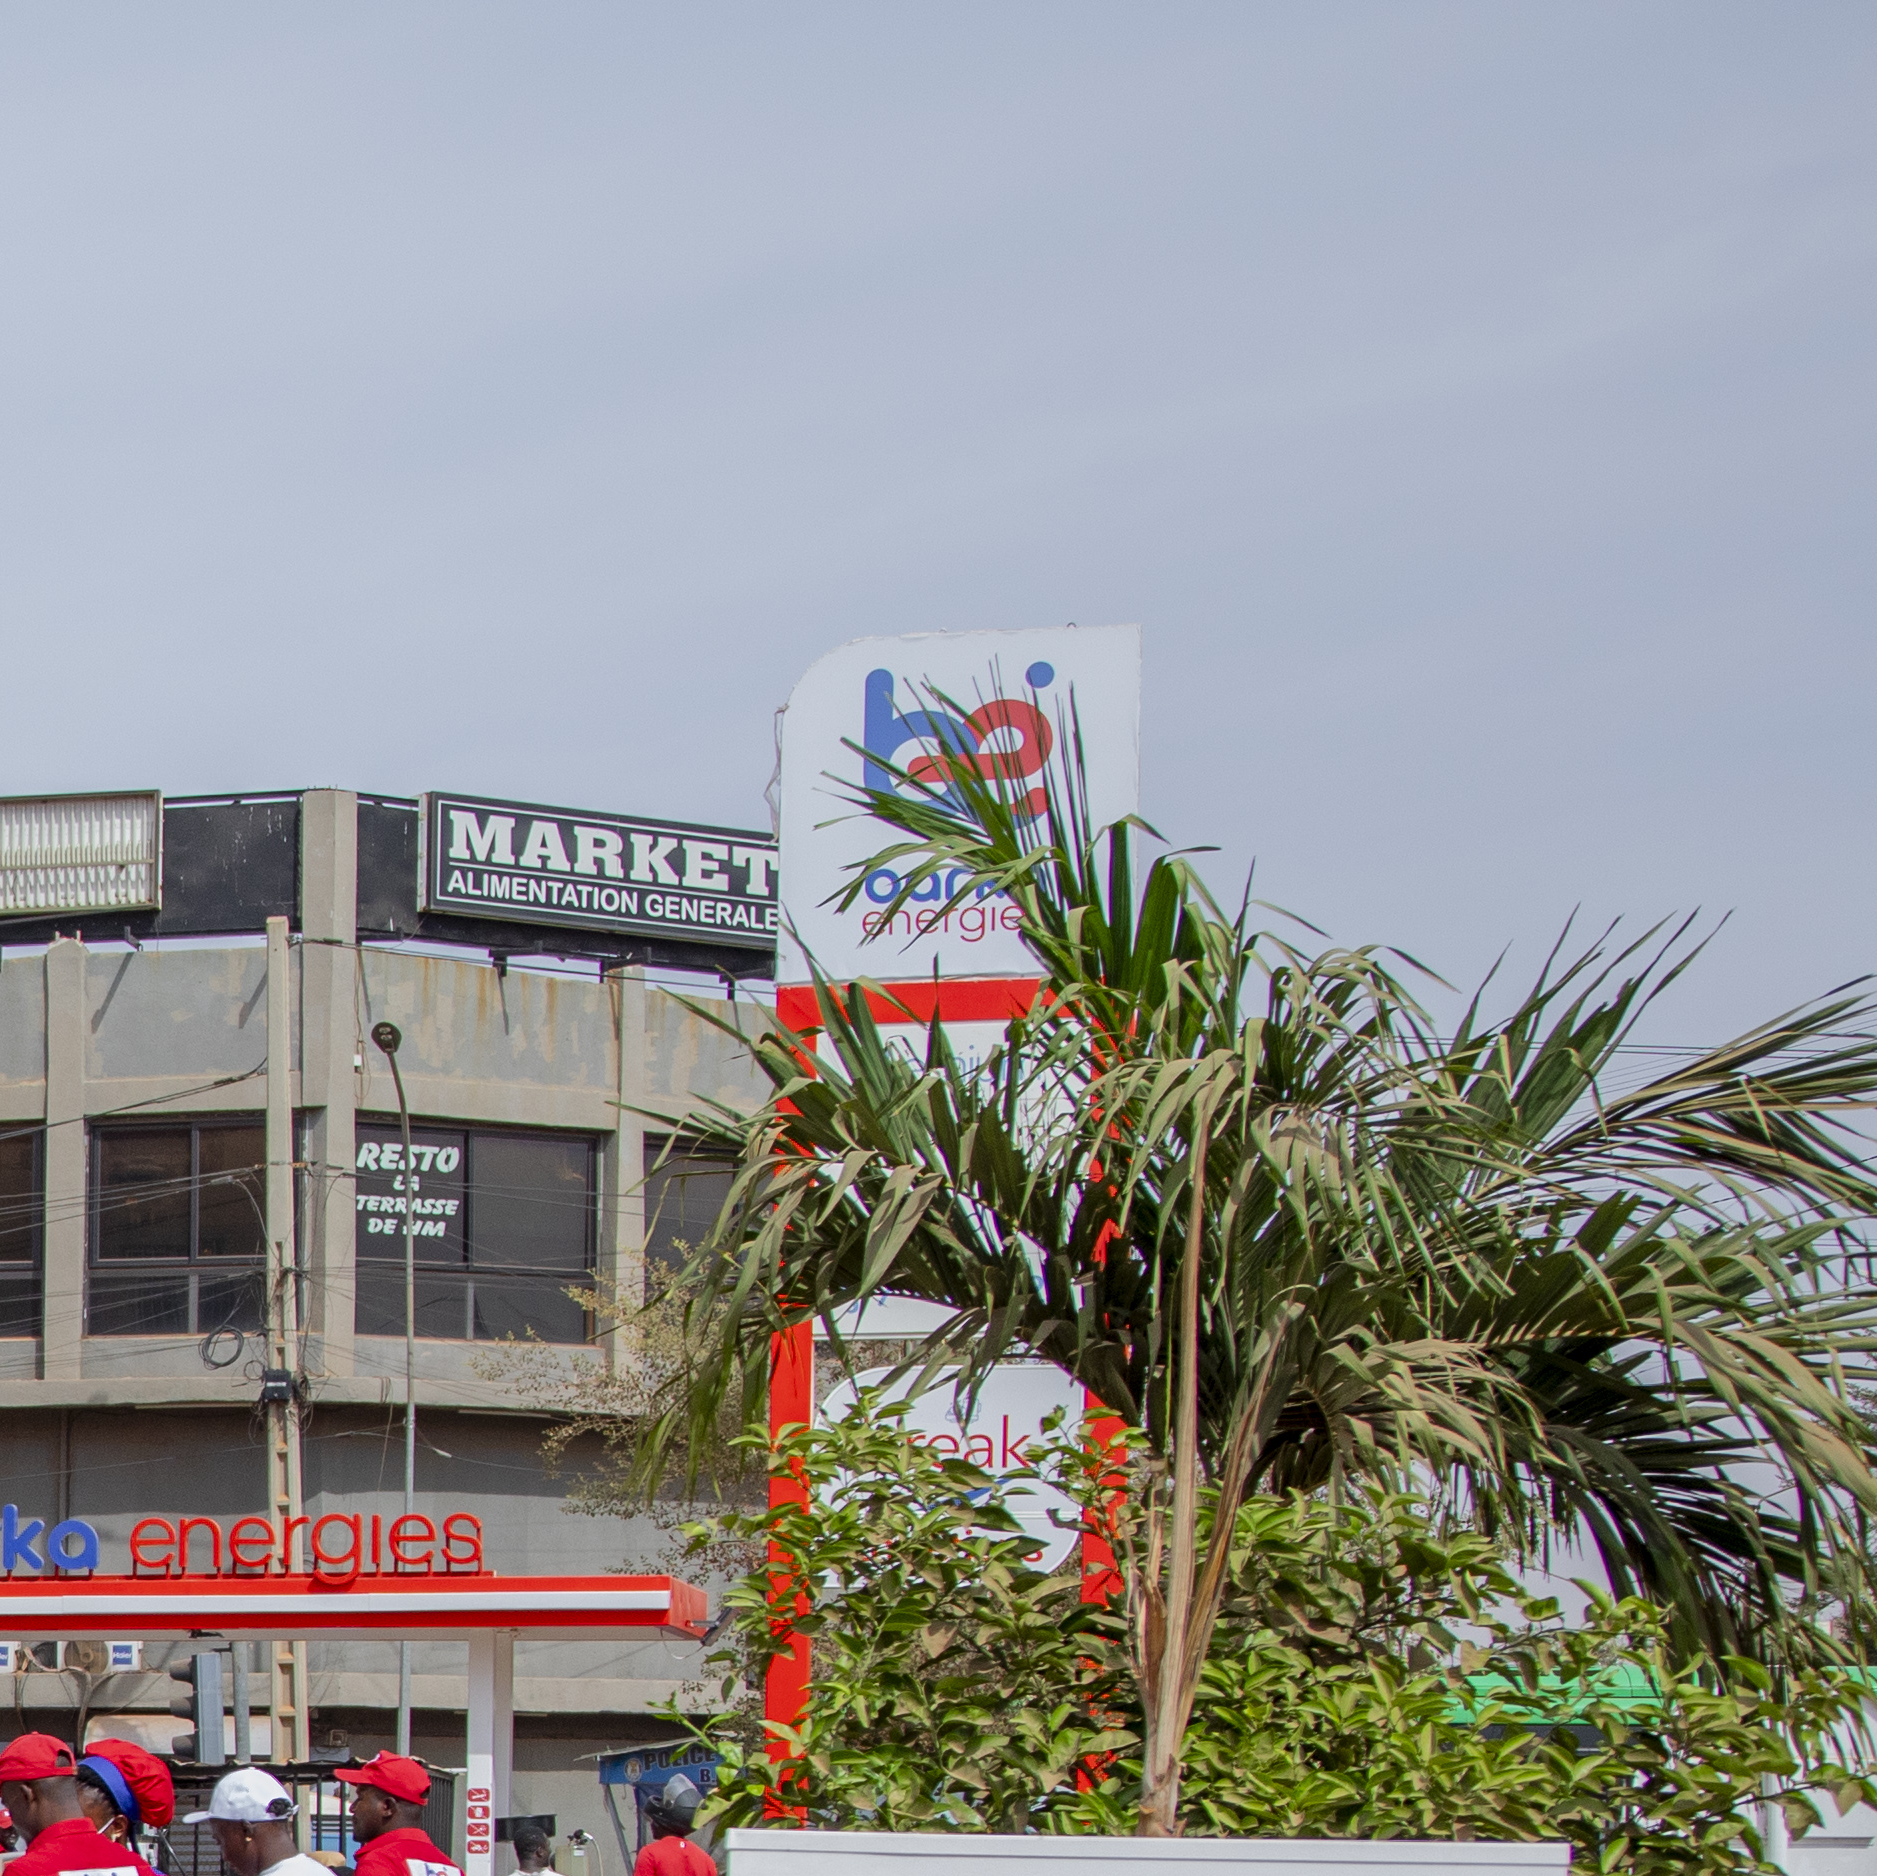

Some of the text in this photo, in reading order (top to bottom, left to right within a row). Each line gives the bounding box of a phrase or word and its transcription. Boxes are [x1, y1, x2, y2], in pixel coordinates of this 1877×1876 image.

[449, 808, 779, 898] MARKET
[447, 870, 779, 932] ALIMENTATION GENERALE
[862, 905, 1026, 943] energie
[392, 1174, 420, 1191] LA
[356, 1194, 460, 1216] TERRASSE
[367, 1217, 398, 1235] DE
[129, 1512, 484, 1585] energies
[112, 1651, 132, 1659] Haier
